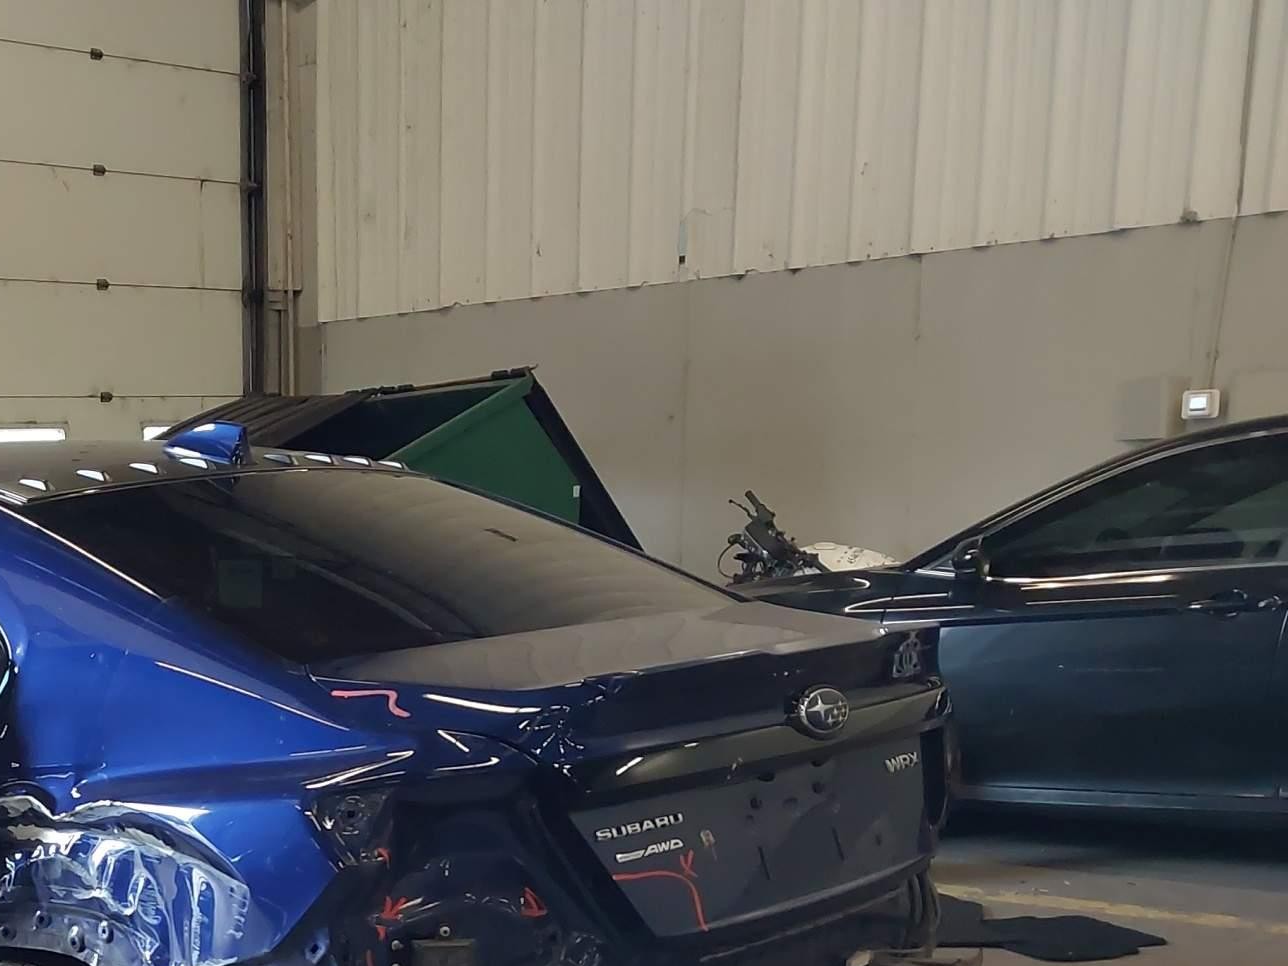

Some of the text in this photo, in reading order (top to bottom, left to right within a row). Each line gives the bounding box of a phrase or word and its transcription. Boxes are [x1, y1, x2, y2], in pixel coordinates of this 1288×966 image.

[885, 752, 918, 773] WRX
[595, 812, 684, 841] SUBARU
[643, 838, 684, 857] AWD
